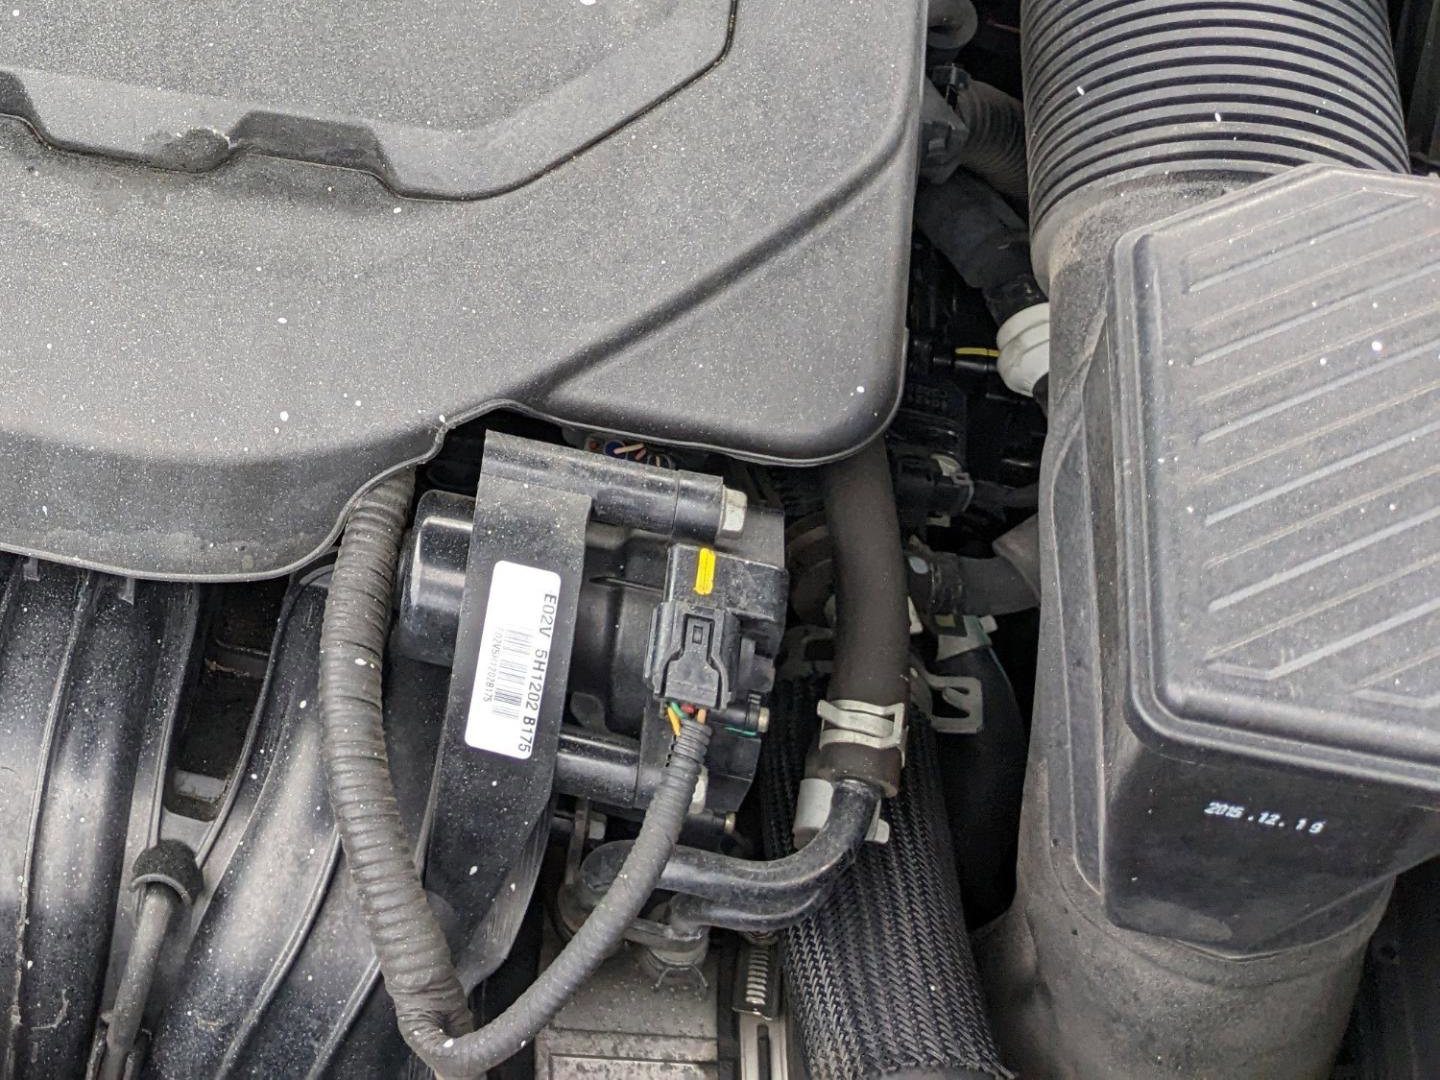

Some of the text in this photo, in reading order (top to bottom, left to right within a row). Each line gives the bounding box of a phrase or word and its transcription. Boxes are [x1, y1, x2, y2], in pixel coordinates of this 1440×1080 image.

[518, 593, 558, 753] E02V 5H1202 B175
